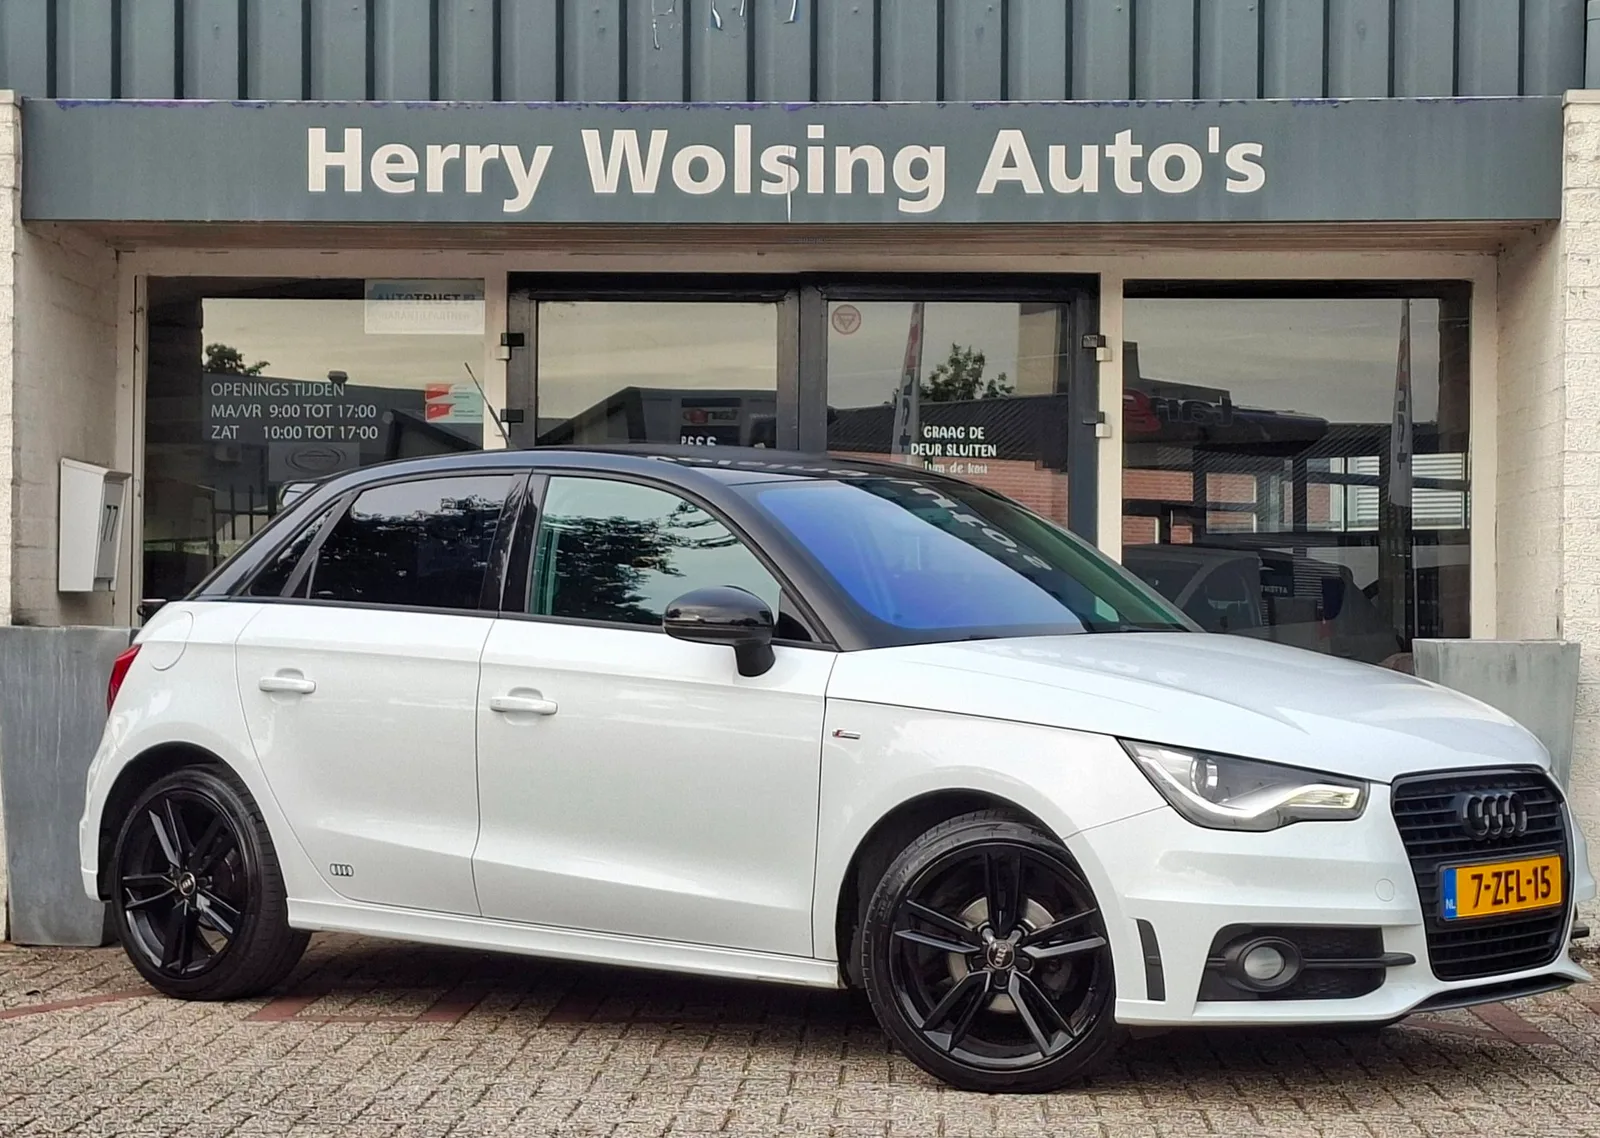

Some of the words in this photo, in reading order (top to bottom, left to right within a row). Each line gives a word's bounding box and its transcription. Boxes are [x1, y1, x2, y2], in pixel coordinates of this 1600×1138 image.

[307, 127, 553, 212] Herry
[580, 124, 945, 213] Wolsing
[975, 126, 1266, 194] Auto's
[210, 382, 290, 397] OPENINGS
[294, 383, 345, 397] TIJDEN
[211, 404, 262, 418] MA/VR
[269, 404, 300, 418] 9:00
[303, 404, 333, 418] TOT
[338, 404, 377, 418] 17:00
[211, 425, 240, 439] ZAT
[263, 425, 302, 440] 10:00
[305, 425, 334, 440] TOT
[340, 425, 379, 440] 17:00
[923, 425, 966, 439] GRAAG
[968, 426, 985, 440] DE
[910, 443, 942, 456] DEUR
[946, 443, 997, 457] SLUITEN
[949, 461, 964, 474] de
[103, 504, 119, 543] 77
[1445, 899, 1457, 910] NL
[1470, 865, 1552, 909] 7-ZFL-15
